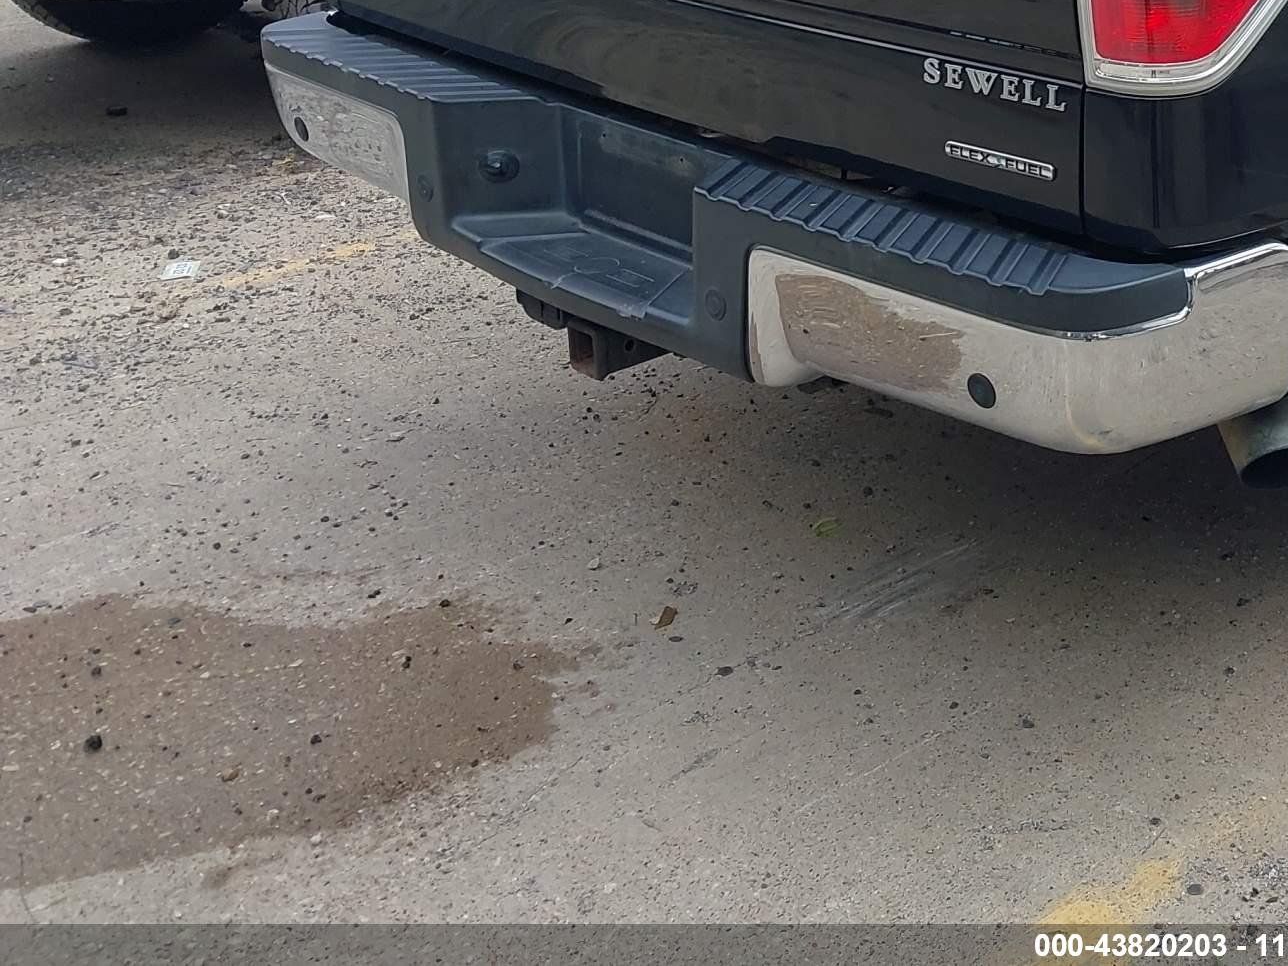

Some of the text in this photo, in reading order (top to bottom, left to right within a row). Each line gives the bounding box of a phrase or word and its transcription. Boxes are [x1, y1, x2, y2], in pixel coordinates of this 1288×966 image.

[923, 57, 1067, 112] SEWELL
[949, 144, 1054, 179] FLEX FUEL
